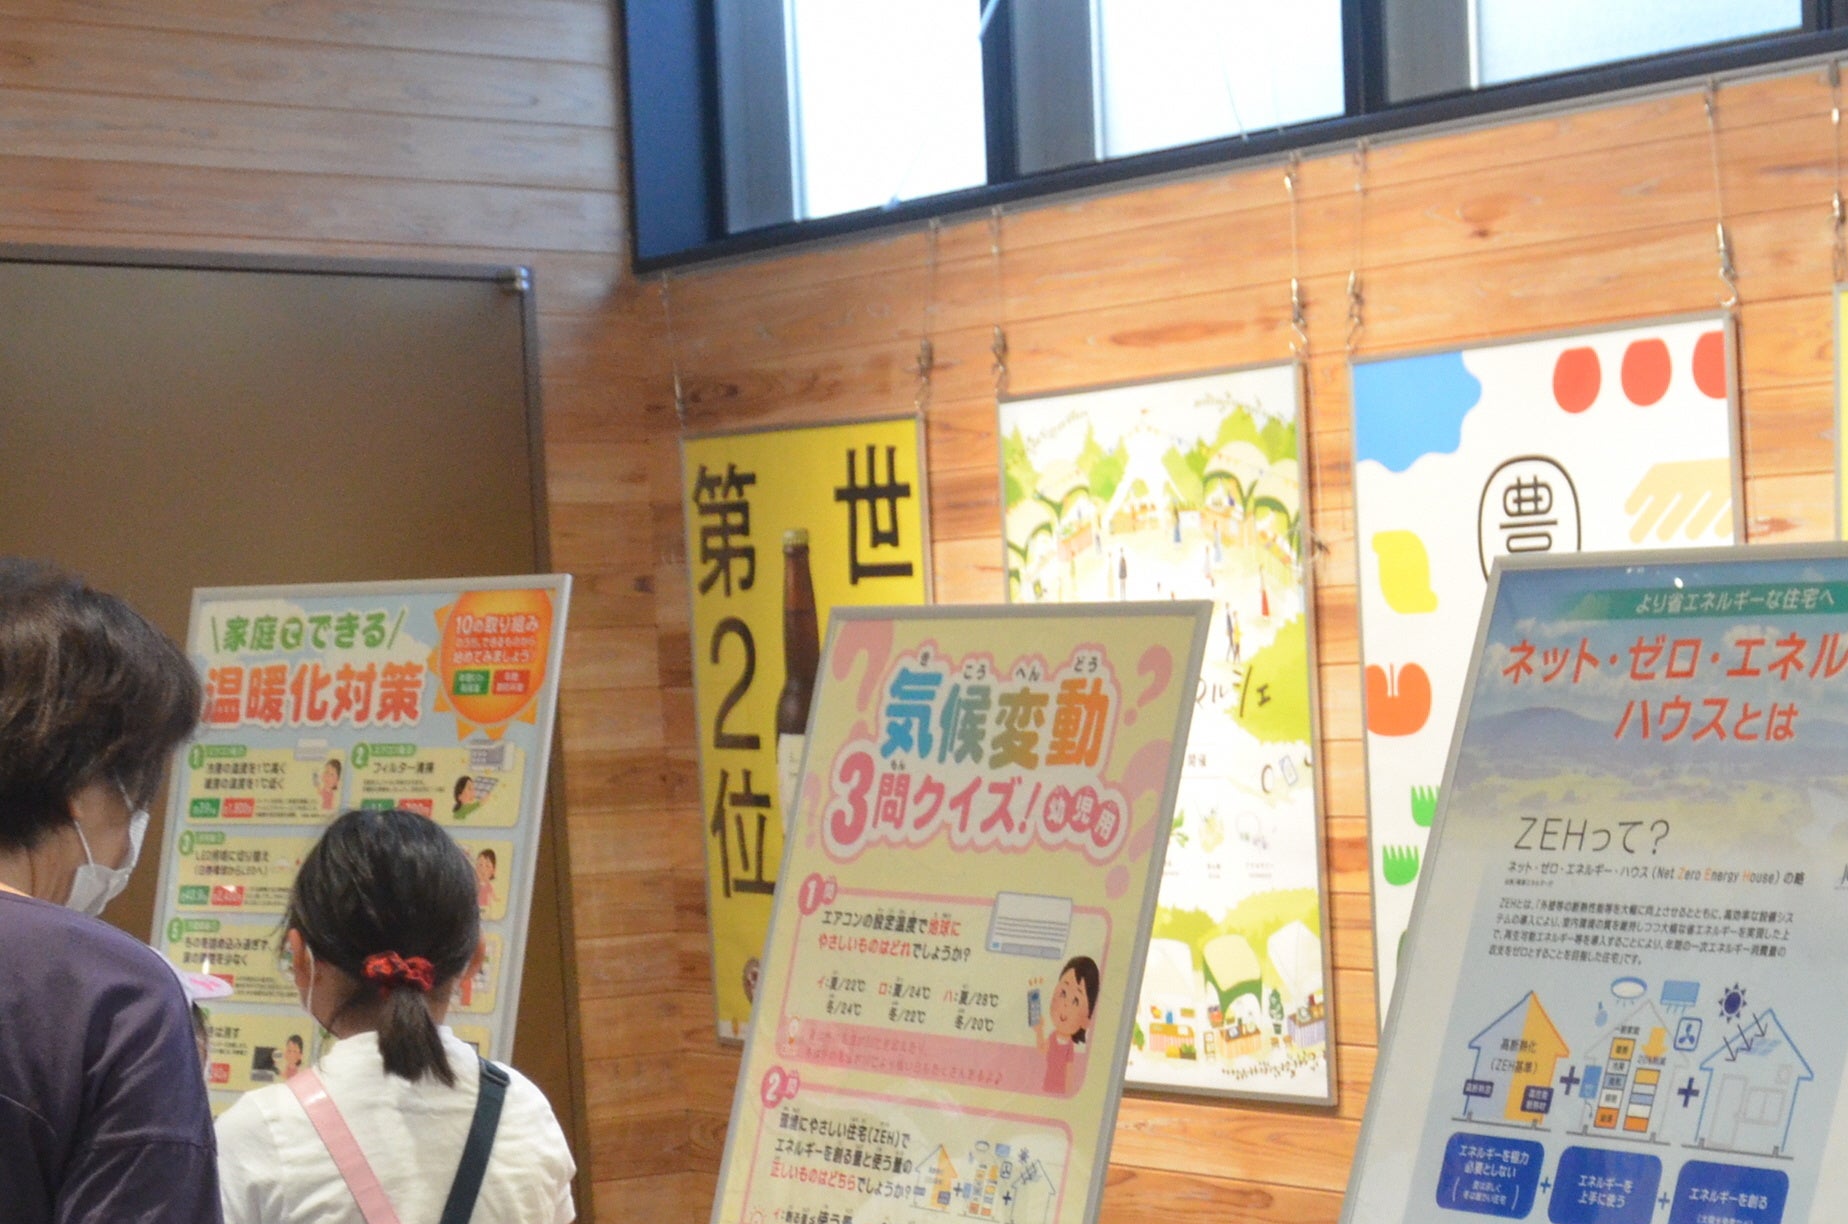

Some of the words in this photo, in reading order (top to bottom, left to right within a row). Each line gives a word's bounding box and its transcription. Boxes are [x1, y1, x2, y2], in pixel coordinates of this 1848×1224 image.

[834, 445, 913, 586] 世
[1635, 588, 1836, 616] より省エネルギーな住宅へ
[203, 660, 425, 725] 温暖化対策
[692, 463, 775, 898] 第2位
[962, 664, 987, 680] こう
[1015, 666, 1041, 682] へん
[1074, 655, 1099, 673] どう
[880, 667, 1110, 771] 気候変動
[1613, 694, 1799, 744] ハウスとは
[830, 751, 1043, 846] 3問クイズ!
[1514, 816, 1671, 856] ZEHって?
[1677, 866, 1701, 882] Zero
[1704, 868, 1740, 884] Energy
[818, 933, 972, 963] やさしいものはどれでしょうか?
